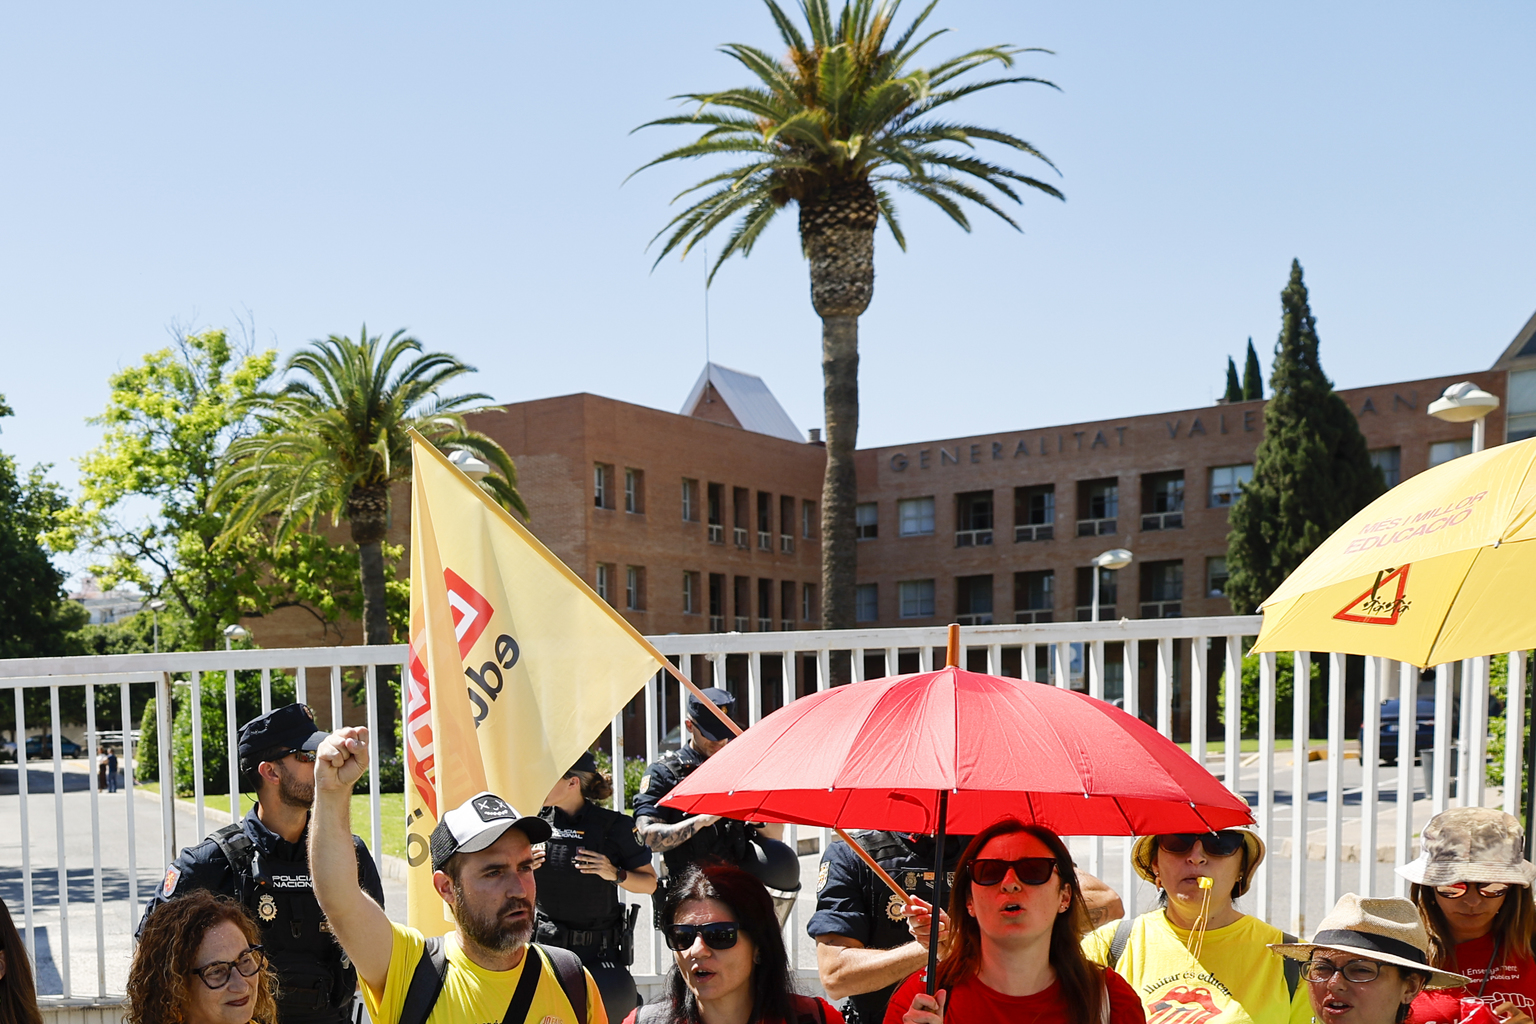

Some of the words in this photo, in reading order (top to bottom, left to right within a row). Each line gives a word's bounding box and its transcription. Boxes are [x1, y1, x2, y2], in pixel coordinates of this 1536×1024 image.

[889, 426, 1127, 472] GENERALITAT
[1411, 490, 1489, 523] MILLOR
[1197, 972, 1233, 997] educar
[542, 1016, 551, 1024] JO
